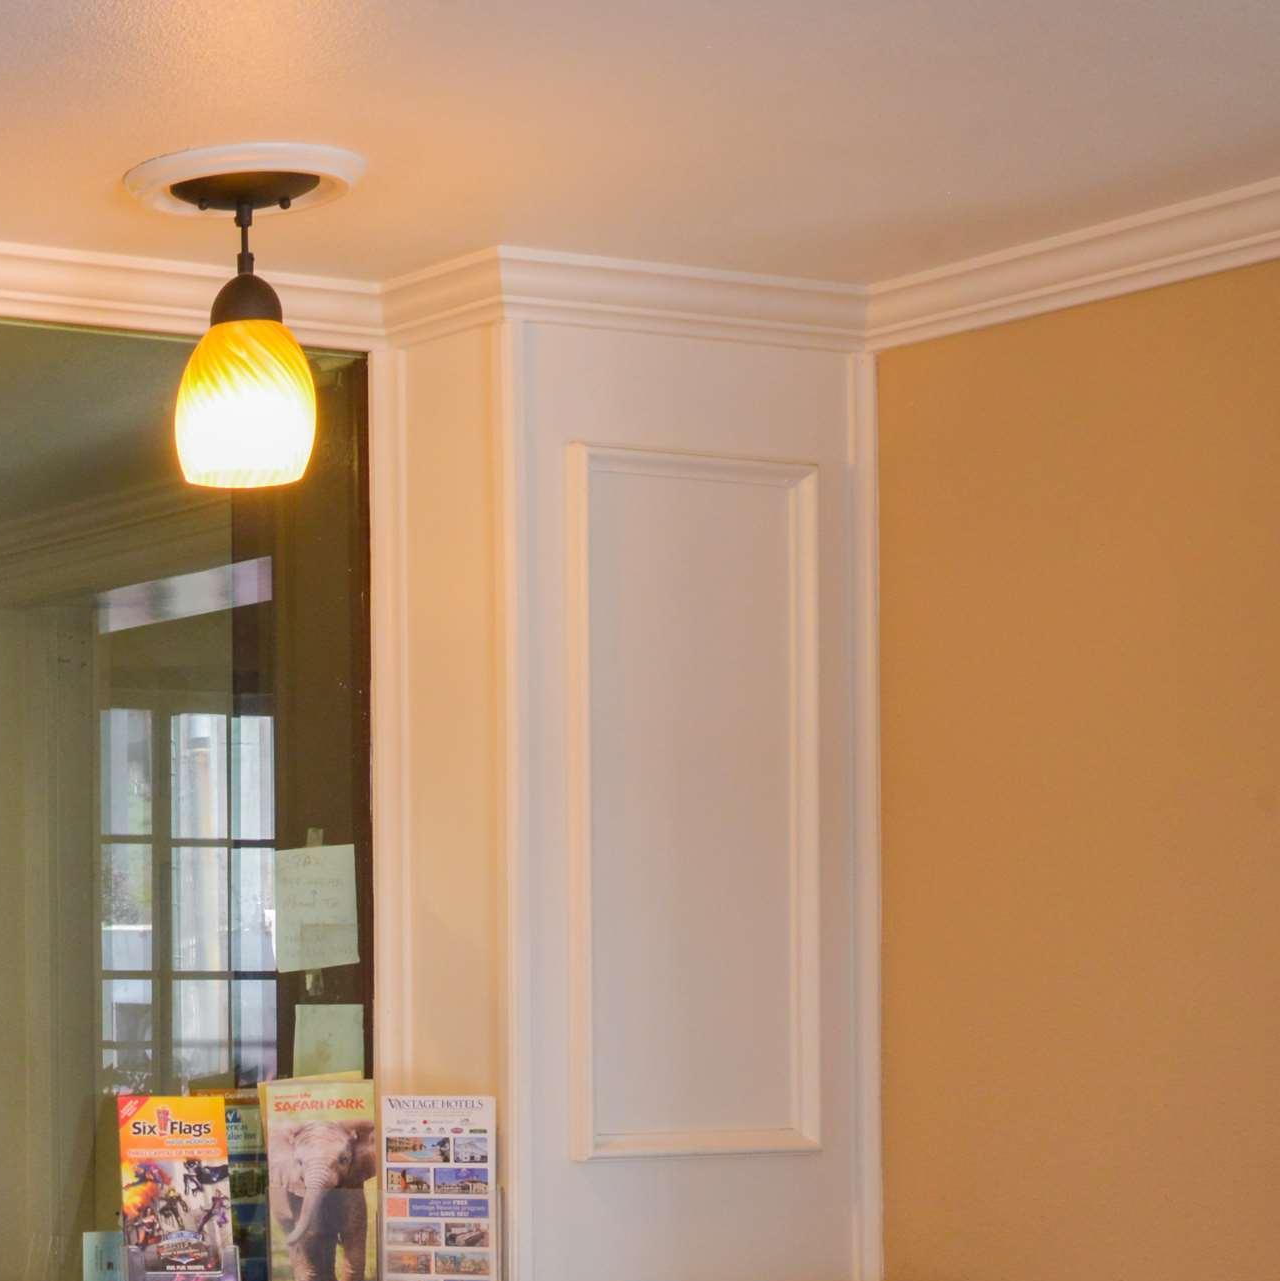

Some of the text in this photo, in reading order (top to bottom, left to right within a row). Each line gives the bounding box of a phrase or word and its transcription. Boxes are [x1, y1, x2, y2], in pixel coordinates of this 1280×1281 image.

[273, 1099, 365, 1112] SAFARI PARK
[386, 1097, 484, 1110] VANTAGE HOTELS
[132, 1121, 212, 1137] Six Flags
